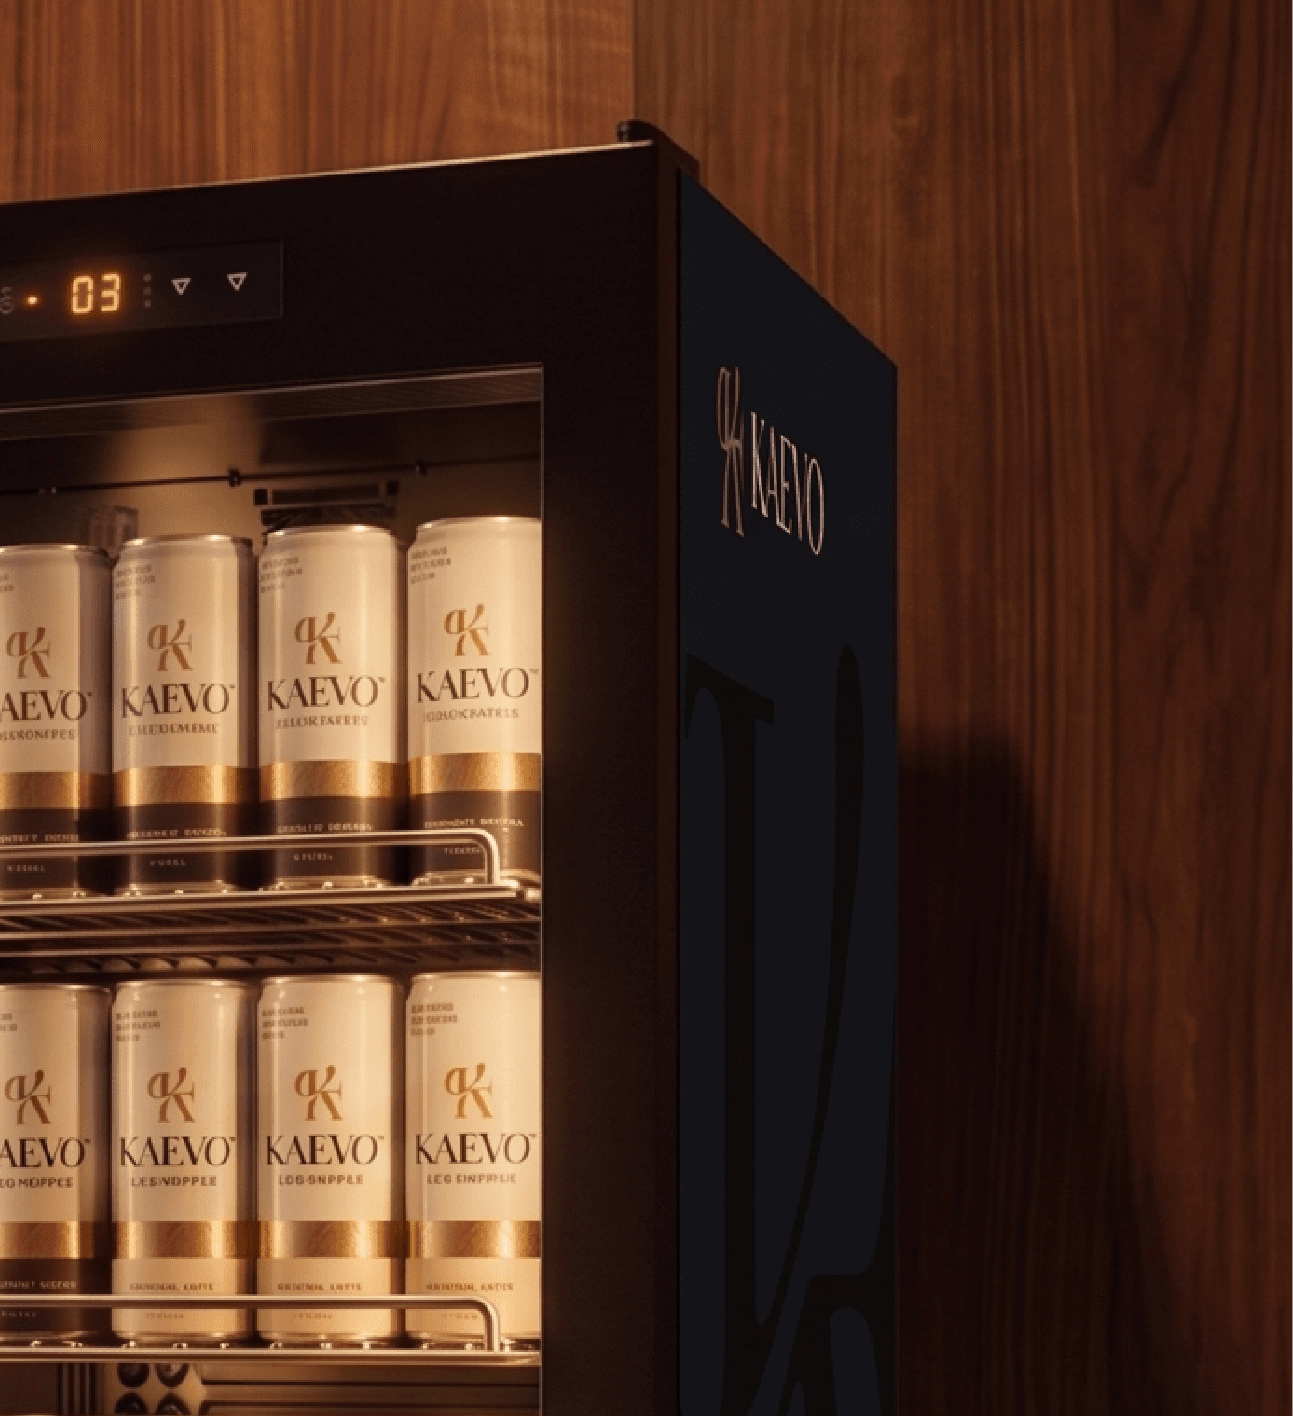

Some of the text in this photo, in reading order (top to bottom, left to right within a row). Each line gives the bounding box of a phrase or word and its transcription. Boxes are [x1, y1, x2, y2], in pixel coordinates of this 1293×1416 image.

[72, 272, 123, 315] 03
[751, 411, 824, 556] KAEVO
[122, 683, 229, 718] KAEVO
[267, 675, 378, 711] KAEVO
[417, 667, 530, 703] KAEVO
[120, 1136, 231, 1168] KAEVO
[266, 1133, 378, 1165] KAEVO
[415, 1133, 530, 1165] KAEVO
